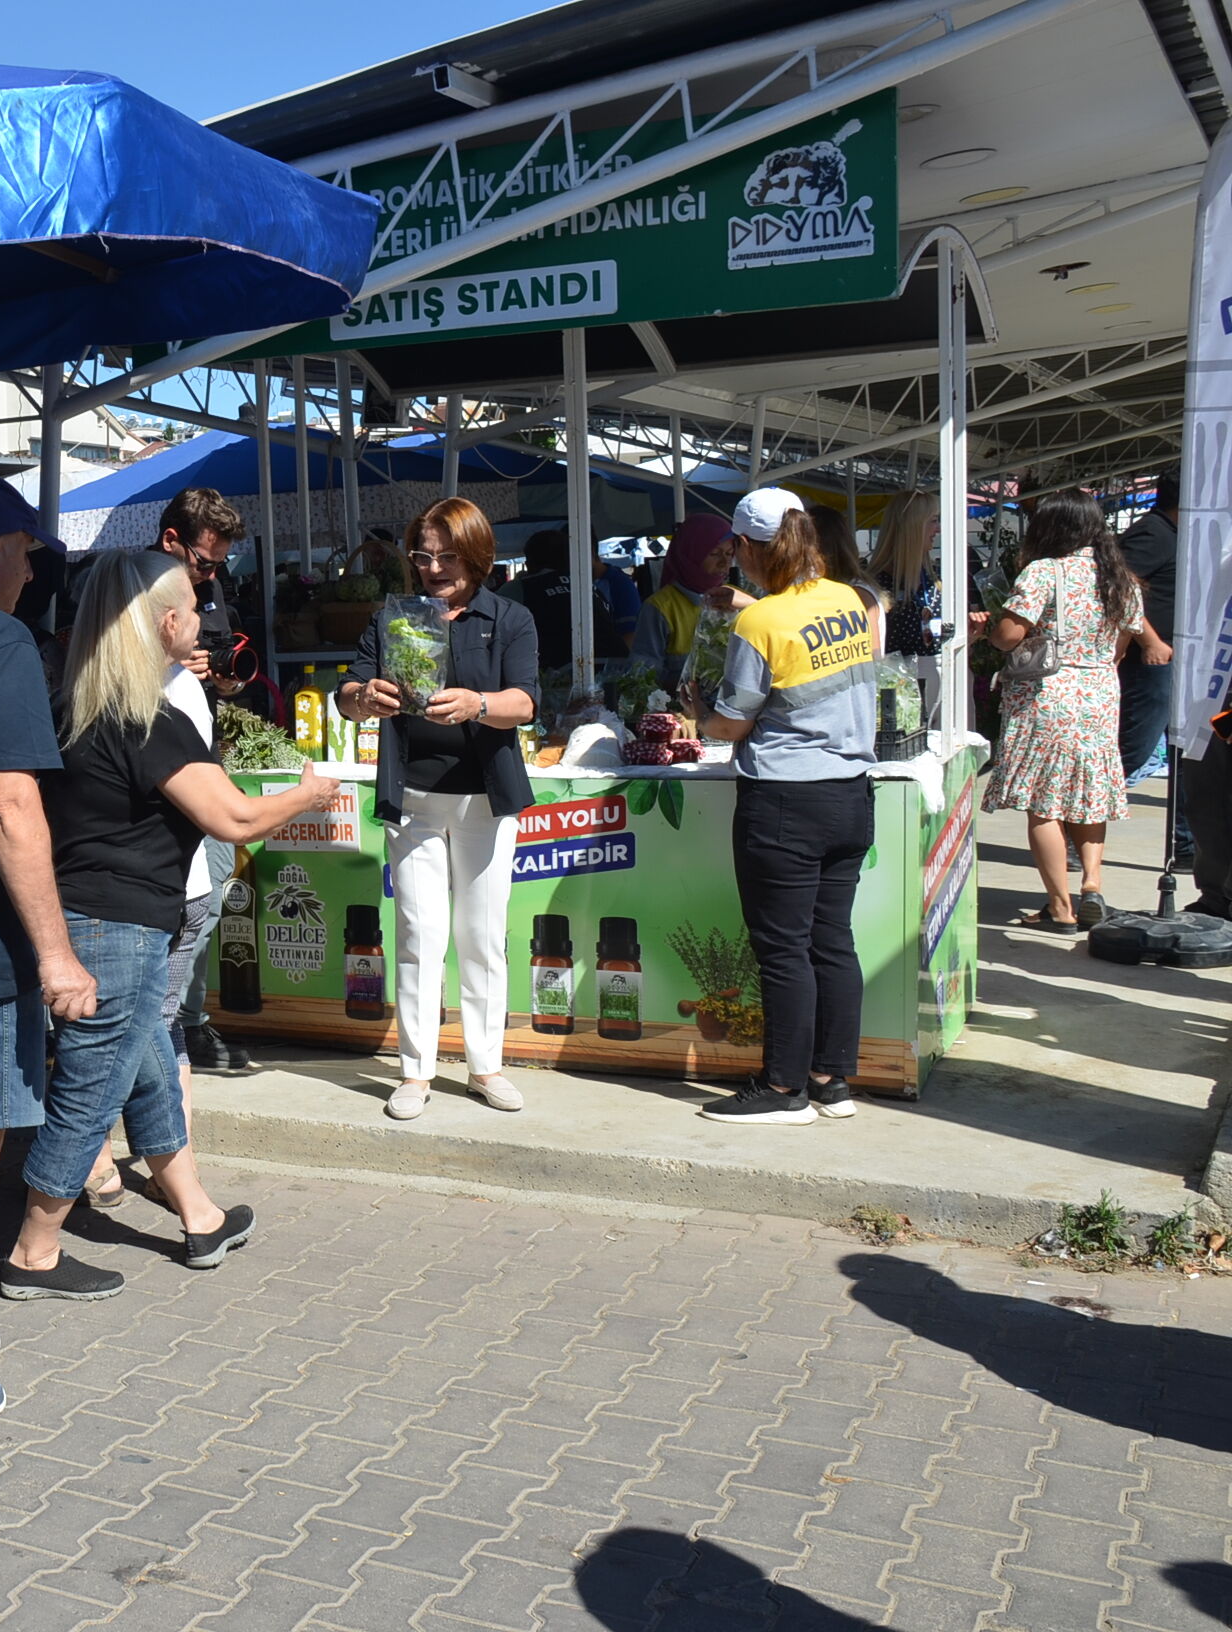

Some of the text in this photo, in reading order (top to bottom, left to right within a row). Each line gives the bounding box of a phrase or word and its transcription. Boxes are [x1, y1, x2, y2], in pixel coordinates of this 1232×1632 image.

[342, 269, 601, 327] SATIŞ STANDI
[799, 609, 868, 653] DİDİM
[557, 805, 620, 829] YOLU
[512, 841, 628, 874] KALİTEDİR
[279, 868, 309, 884] DOĞAL
[266, 923, 327, 945] DELİCE
[269, 946, 324, 961] ZEYTİNYAĞI
[272, 960, 321, 970] OLIVE OIL
